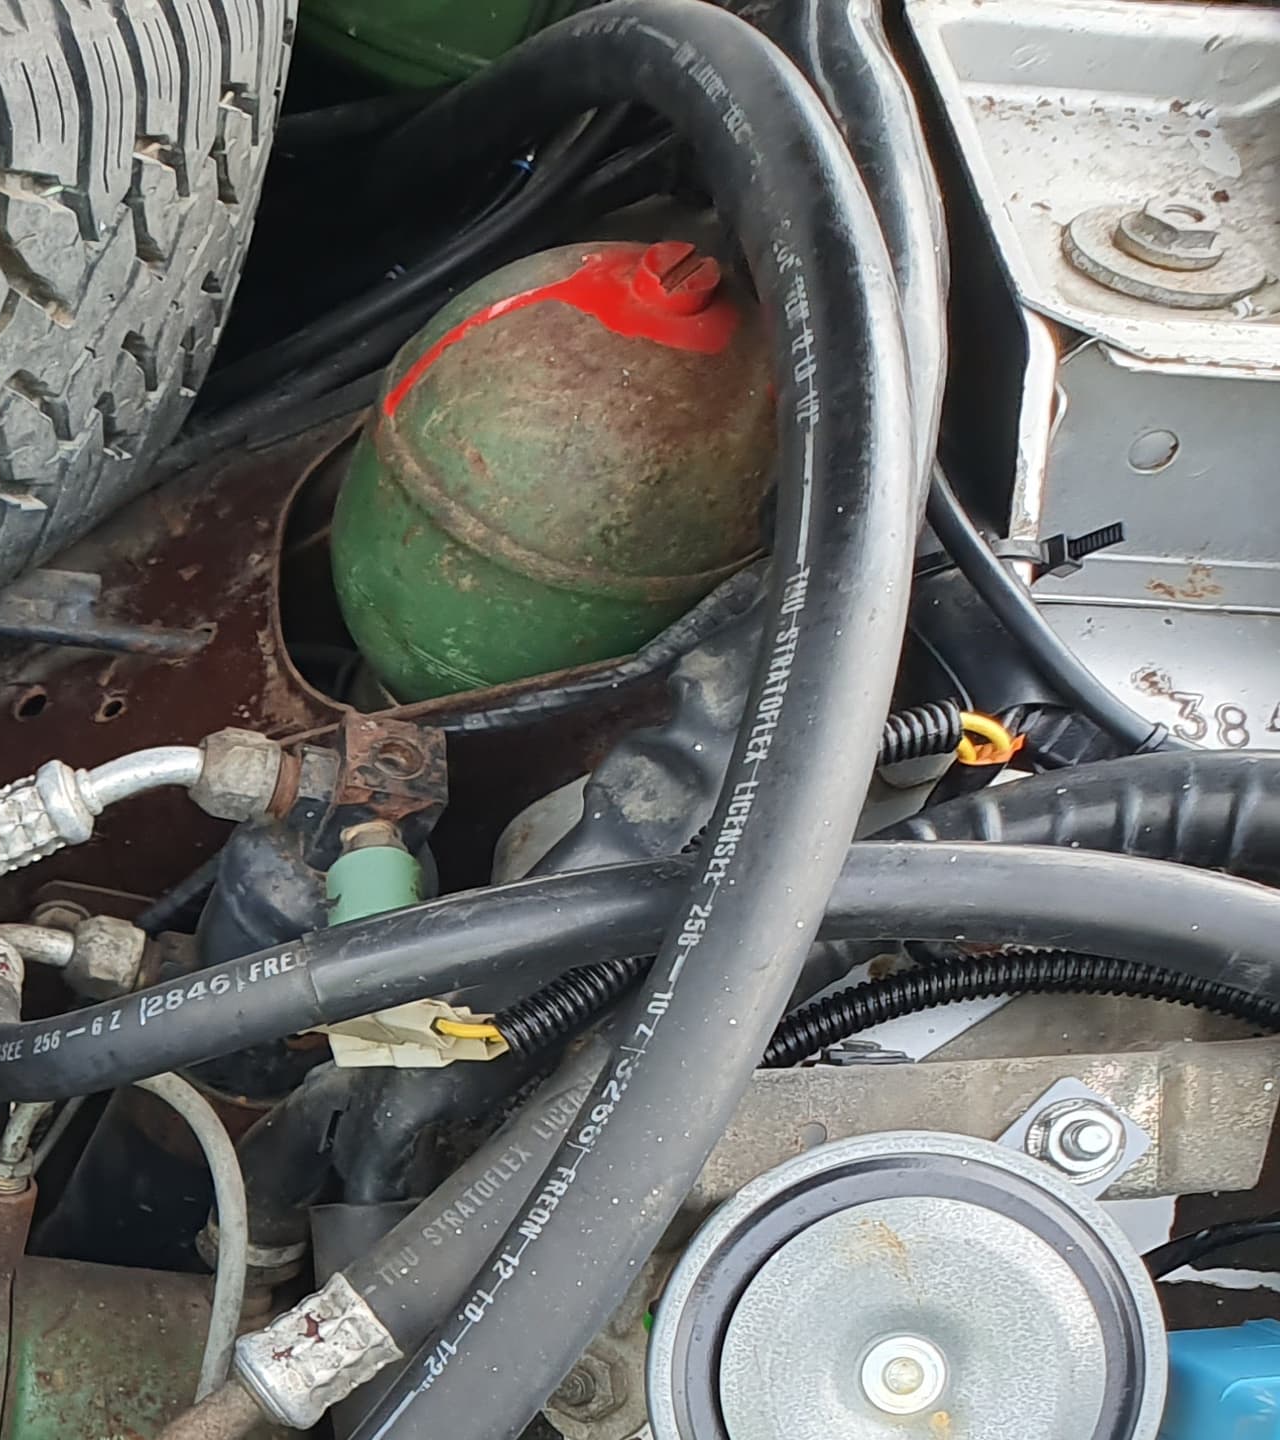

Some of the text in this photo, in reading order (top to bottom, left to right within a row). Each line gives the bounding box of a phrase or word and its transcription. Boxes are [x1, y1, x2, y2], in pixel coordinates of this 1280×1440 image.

[743, 626, 801, 765] STRATOFLEX
[421, 1144, 534, 1248] STRATOFLEX
[517, 1165, 578, 1242] FREON
